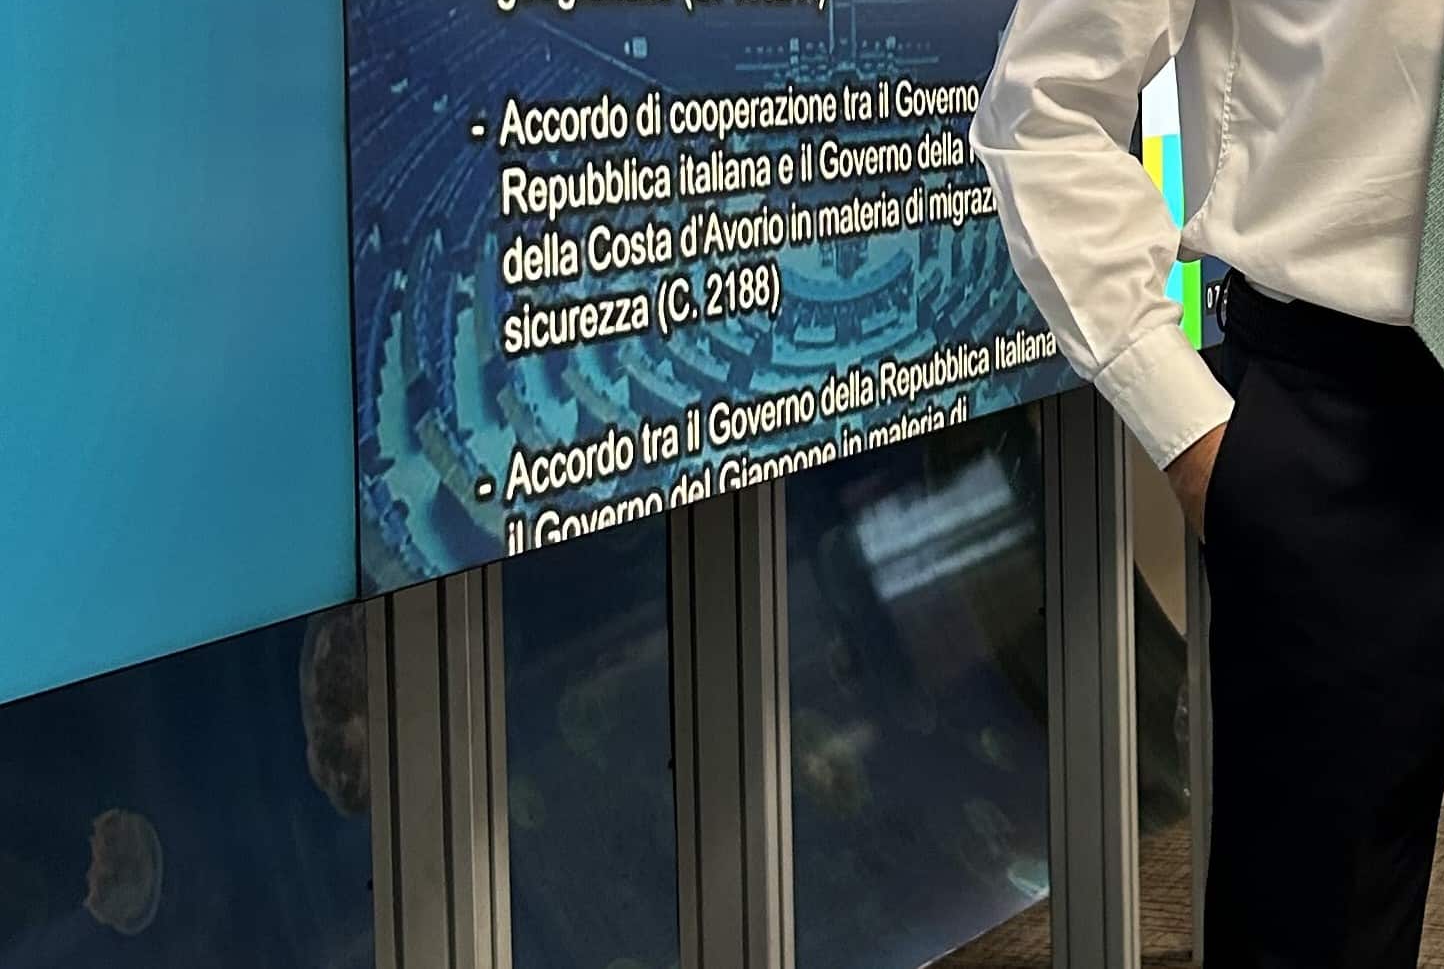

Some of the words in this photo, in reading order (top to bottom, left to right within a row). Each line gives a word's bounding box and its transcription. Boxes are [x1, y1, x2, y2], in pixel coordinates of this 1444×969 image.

[500, 95, 628, 147] Accordo
[636, 91, 661, 137] di
[669, 85, 837, 140] cooperazione
[843, 85, 872, 122] tra
[878, 81, 889, 118] il
[895, 79, 979, 118] Governo
[502, 157, 671, 222] Repubblica
[679, 149, 771, 196] italiana
[778, 153, 794, 184] e
[801, 143, 813, 182] il
[819, 140, 912, 180] Governo
[917, 131, 964, 170] della
[503, 235, 579, 285] della
[588, 222, 672, 271] Costa
[680, 206, 784, 258] d'Avorio
[791, 202, 811, 242] in
[819, 191, 900, 238] materia
[905, 187, 923, 225] di
[504, 303, 649, 353] sicurezza
[658, 278, 698, 334] (C.
[707, 264, 780, 316] 2188)
[506, 429, 634, 501] Accordo
[642, 422, 679, 465] tra
[687, 409, 700, 453] il
[709, 392, 815, 446] Governo
[821, 370, 874, 416] della
[880, 343, 989, 401] Repubblica
[995, 330, 1056, 370] Italiana
[508, 519, 523, 557] il
